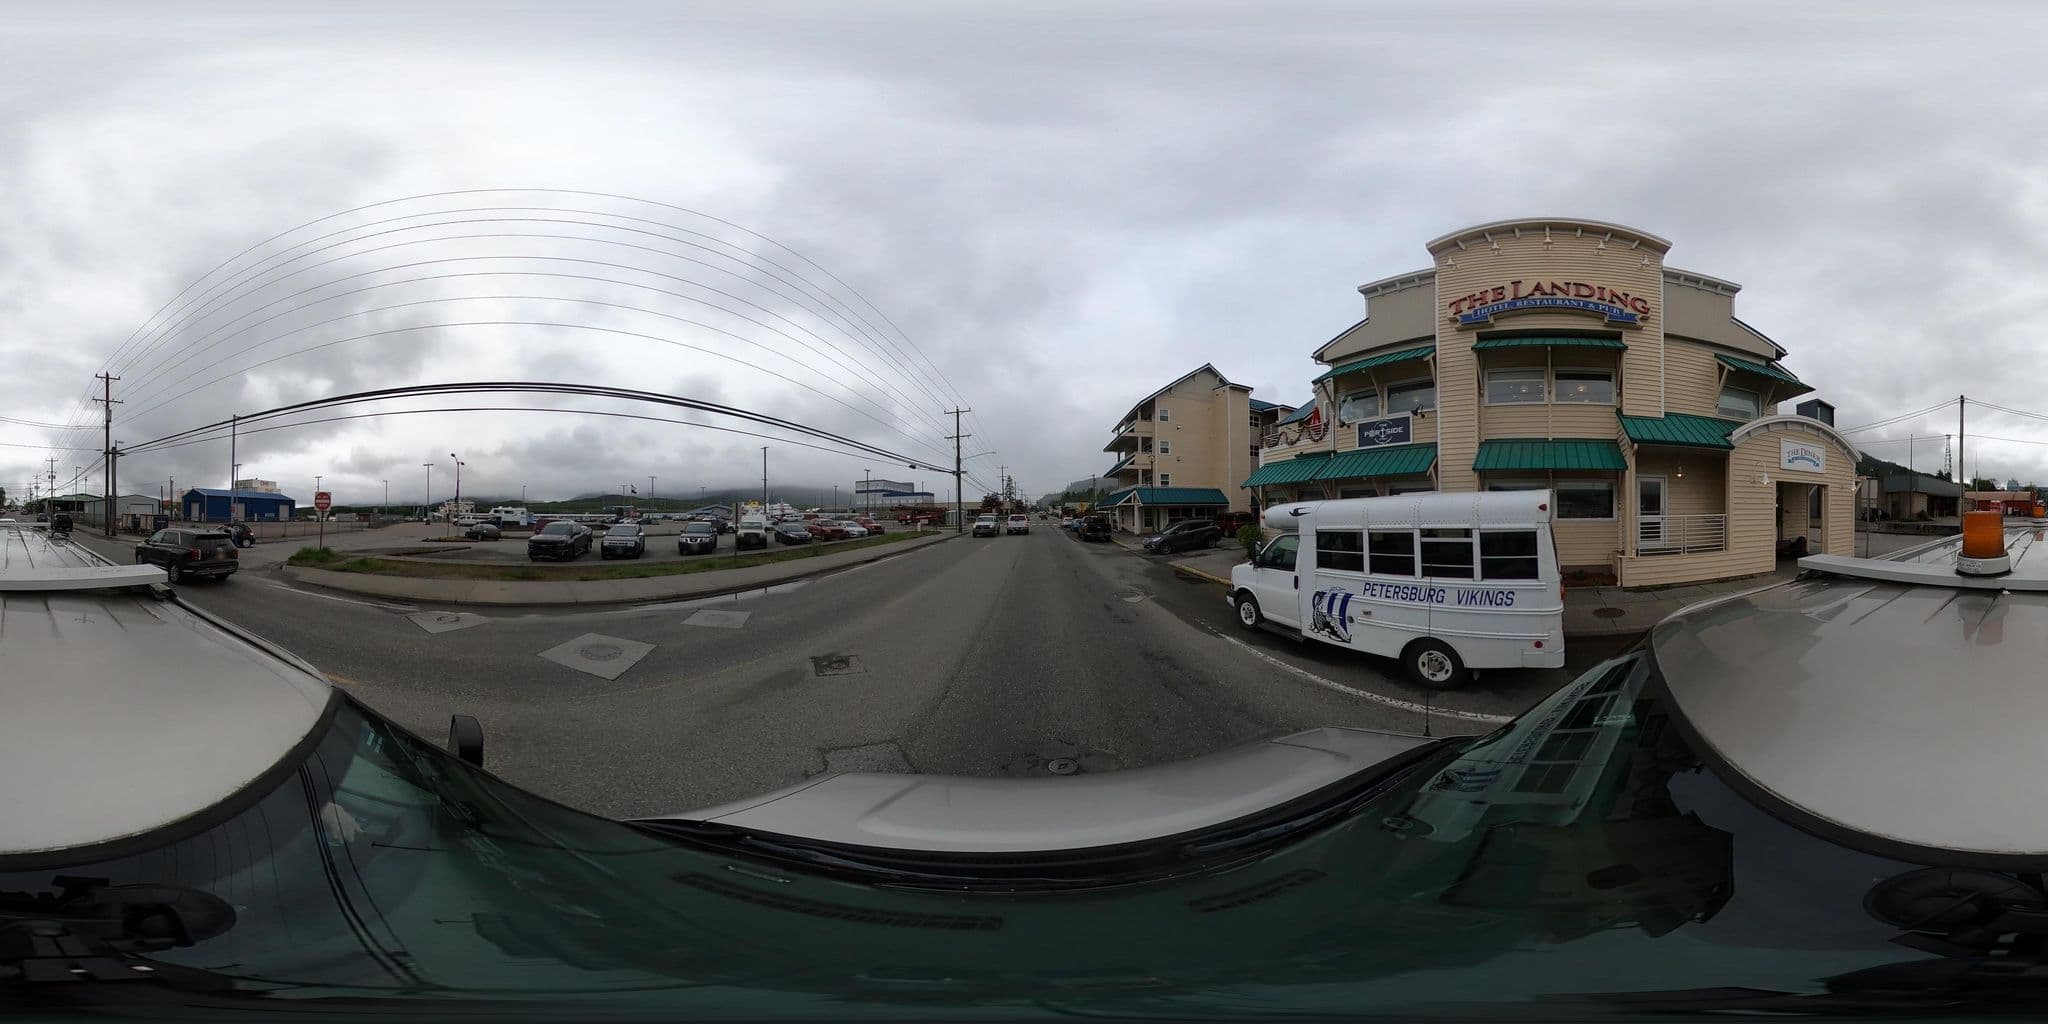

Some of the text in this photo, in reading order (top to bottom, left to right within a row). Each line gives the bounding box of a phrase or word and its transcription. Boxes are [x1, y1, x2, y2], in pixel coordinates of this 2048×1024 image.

[1449, 280, 1650, 315] THE LANDING
[1516, 298, 1584, 308] RESTAURANT
[1599, 304, 1621, 315] PUB
[1364, 427, 1404, 438] PORTSIDE
[1363, 582, 1516, 607] PETERSBURG VIKINGS
